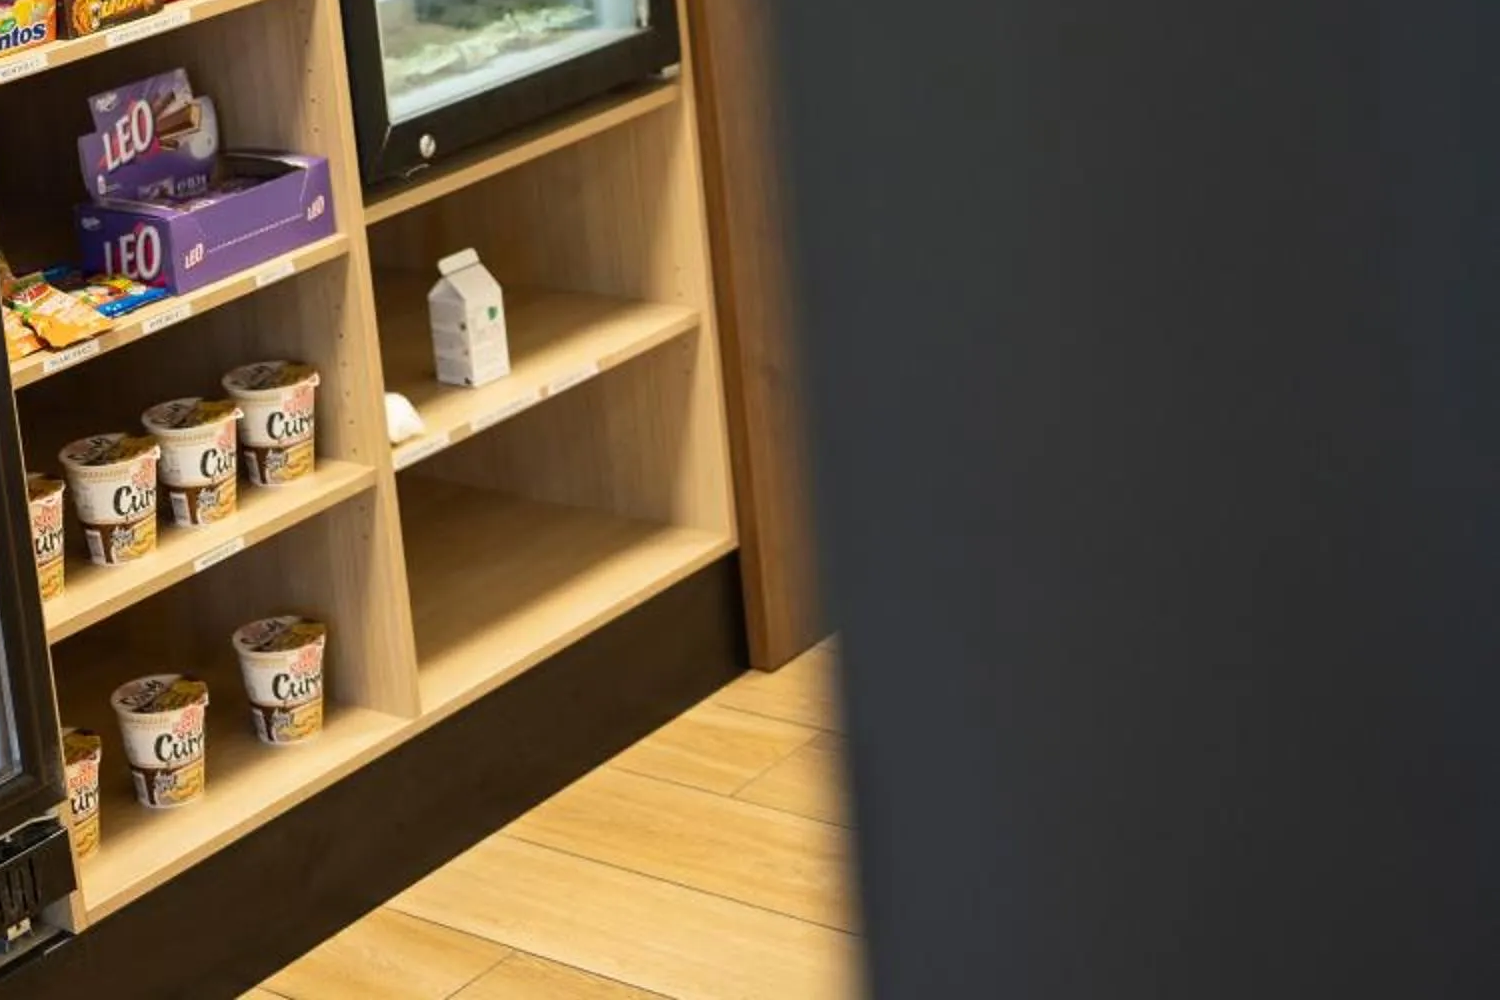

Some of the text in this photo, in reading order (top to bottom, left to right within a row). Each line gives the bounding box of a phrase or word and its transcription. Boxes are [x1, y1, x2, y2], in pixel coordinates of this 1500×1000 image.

[103, 100, 155, 171] LEO
[104, 225, 162, 280] LEO
[184, 243, 204, 269] LEO
[113, 485, 156, 517] Cur
